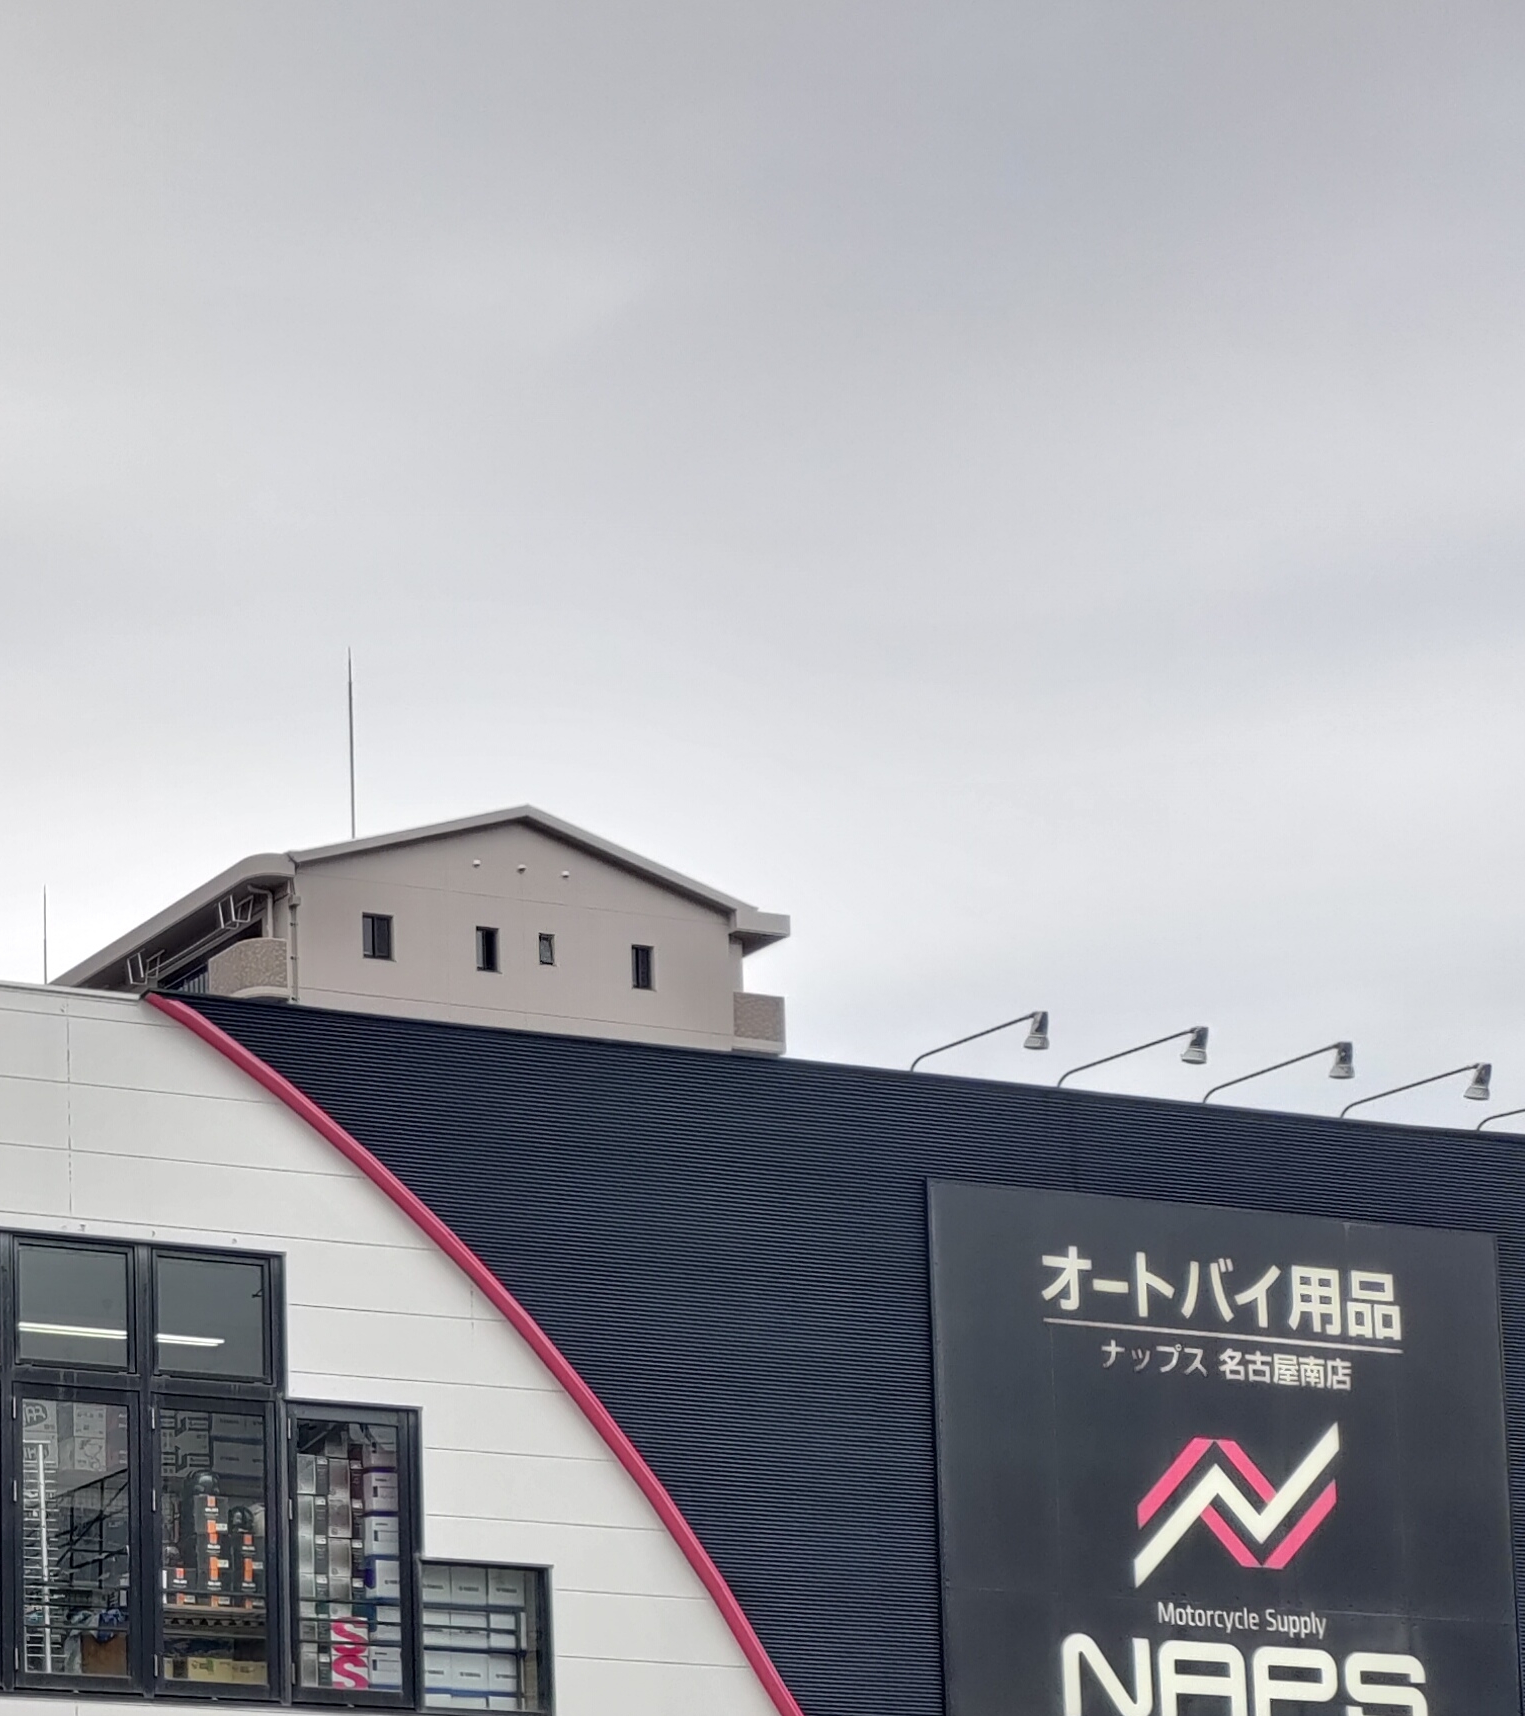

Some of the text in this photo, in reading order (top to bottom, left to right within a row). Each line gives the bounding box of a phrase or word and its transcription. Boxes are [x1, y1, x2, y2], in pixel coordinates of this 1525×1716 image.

[1041, 1246, 1402, 1341] オートバイ用品
[1101, 1340, 1351, 1390] ナップス 名古屋南店
[1158, 1602, 1327, 1639] Motorcycle Supply
